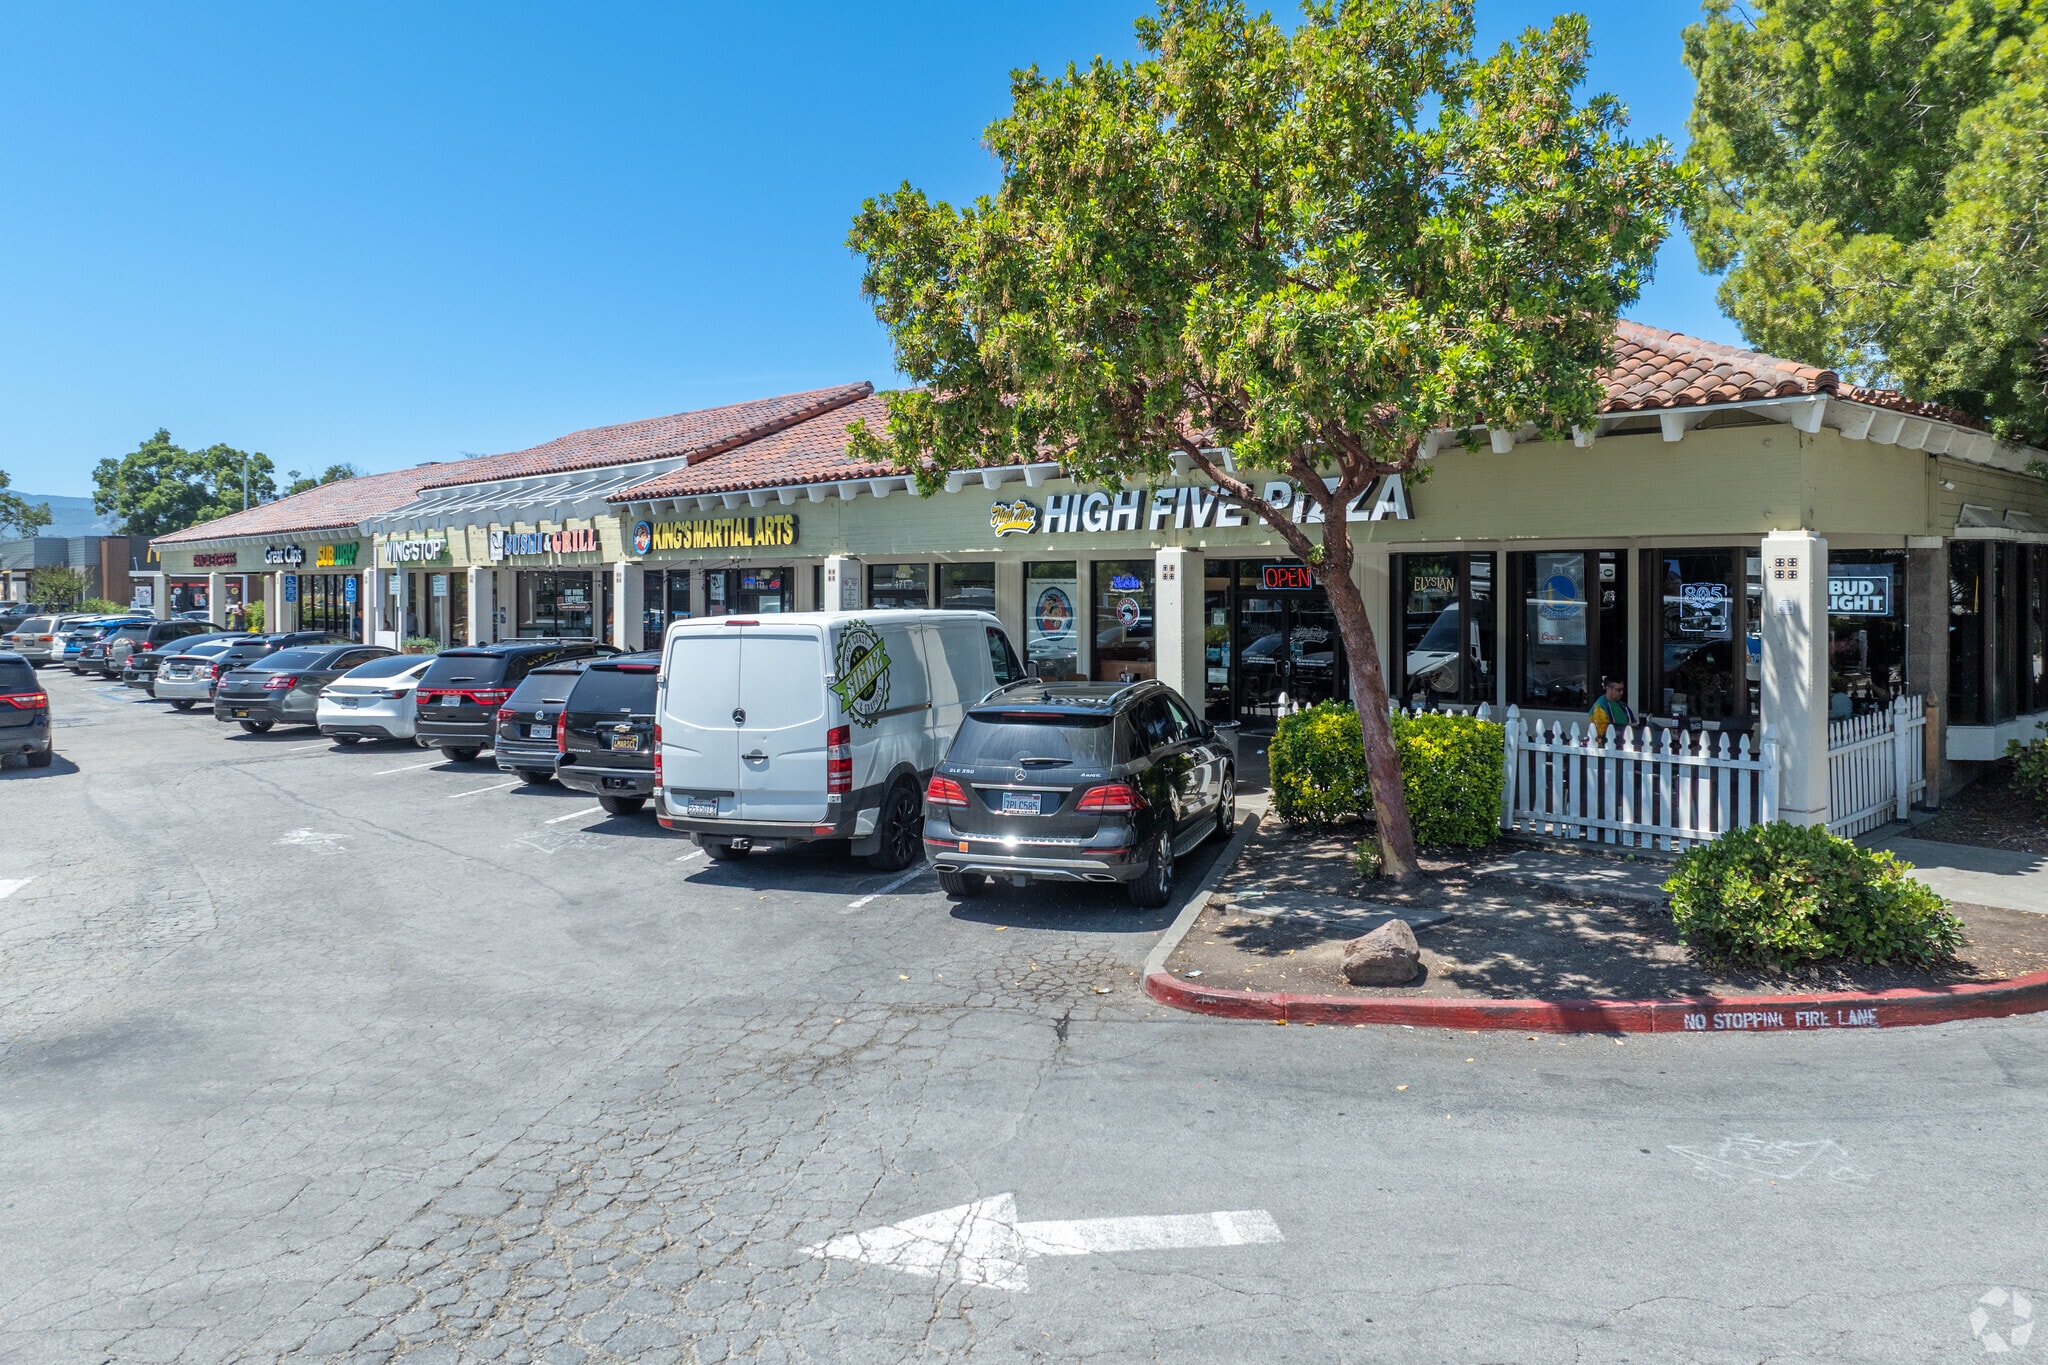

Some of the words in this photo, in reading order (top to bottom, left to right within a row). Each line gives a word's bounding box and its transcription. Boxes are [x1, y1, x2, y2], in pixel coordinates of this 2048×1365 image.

[1042, 490, 1141, 533] HIGH
[1149, 485, 1244, 530] FIVE
[504, 532, 543, 555] SUSHI
[543, 534, 552, 552] &
[552, 528, 597, 553] GRILL
[653, 521, 692, 549] KING'S
[693, 517, 752, 548] MARTIAL
[754, 513, 794, 546] ARTS
[265, 546, 284, 565] Great
[284, 545, 302, 568] Clips
[315, 542, 359, 568] SUBWAY
[1265, 567, 1311, 587] OPEN
[1414, 576, 1455, 593] ELYSIAN
[1829, 580, 1875, 596] BUD
[1684, 585, 1723, 603] 805
[852, 634, 868, 646] COAST
[1684, 1013, 1707, 1030] NO
[1837, 1008, 1880, 1028] LANE
